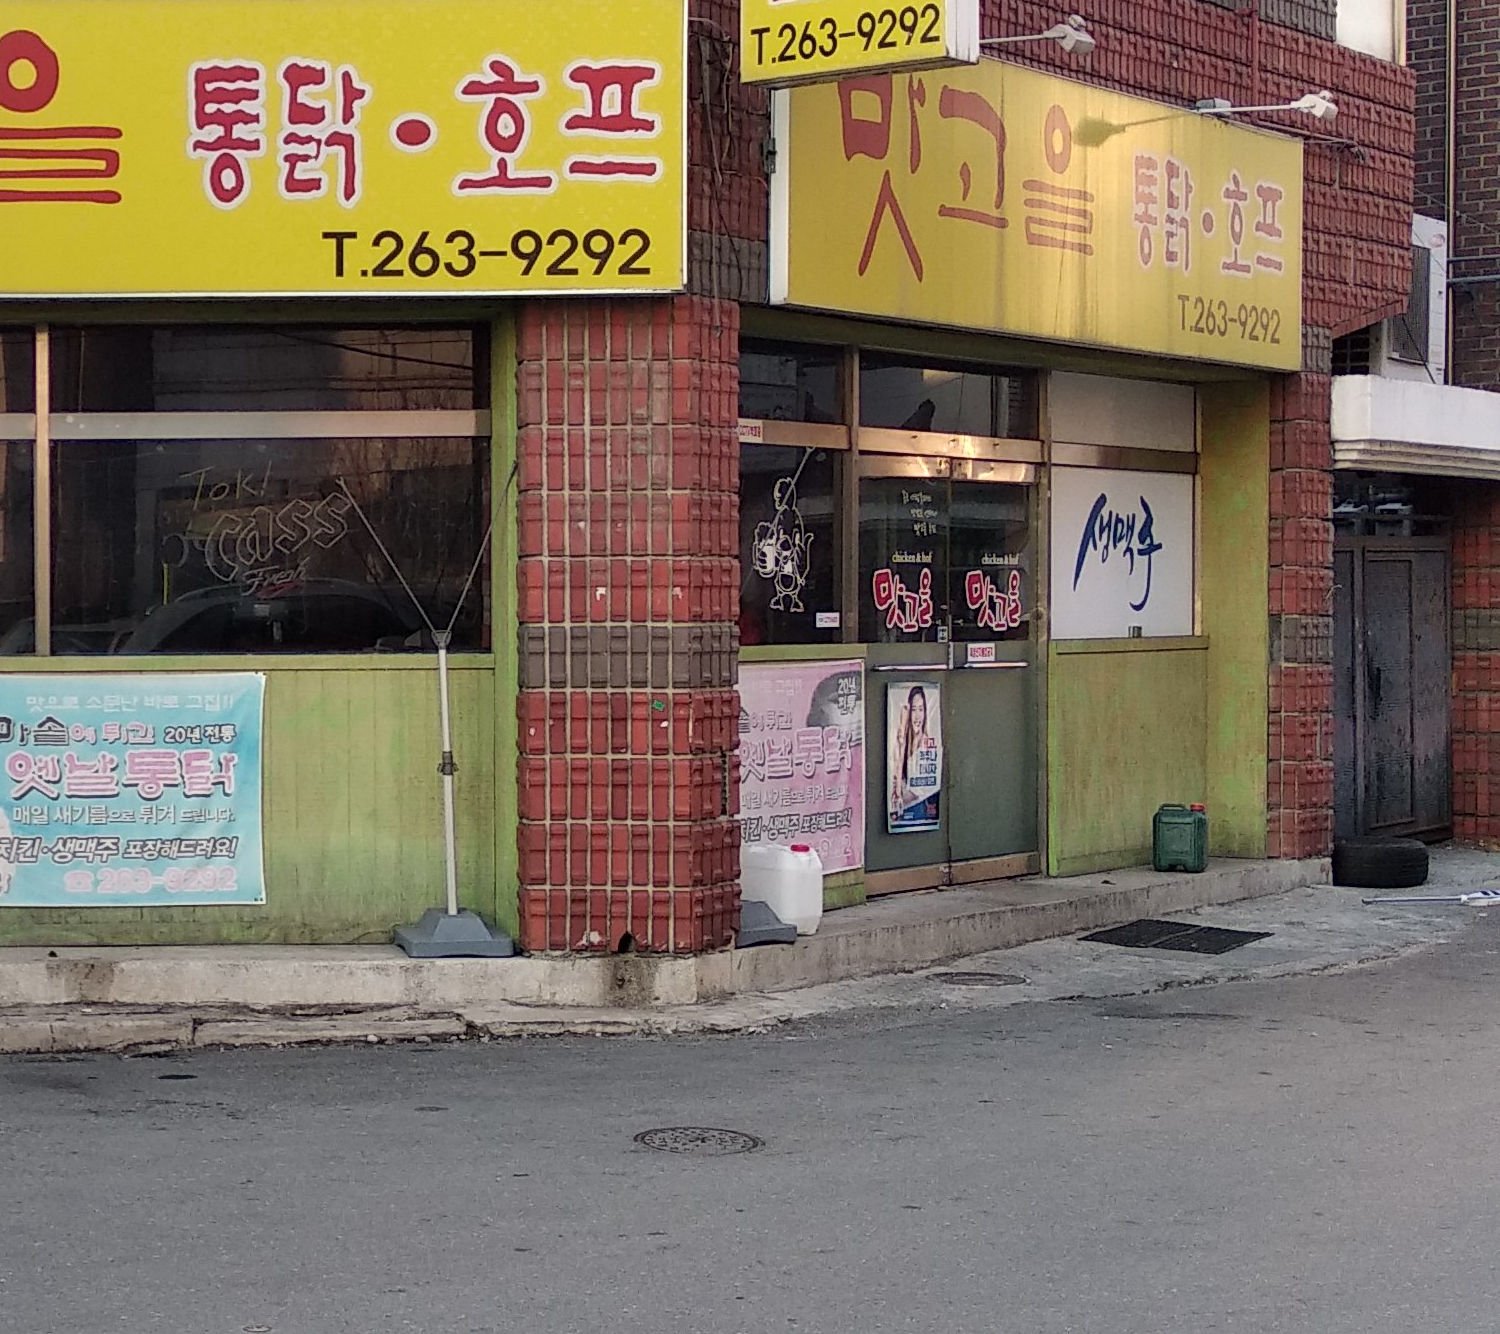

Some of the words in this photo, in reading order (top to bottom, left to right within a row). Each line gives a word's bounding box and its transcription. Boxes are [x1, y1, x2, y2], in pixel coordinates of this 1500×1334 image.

[750, 3, 942, 66] T.263-9292
[837, 75, 1094, 283] 맛고을
[321, 228, 653, 279] T.263-9292
[1177, 293, 1282, 346] T.263-9292
[1073, 493, 1163, 611] 생맥주
[873, 568, 933, 632] 맛고을
[965, 569, 1021, 631] 맛고을
[26, 696, 79, 712] 맛으로
[86, 695, 137, 712] 소문난
[163, 723, 202, 744] 20년
[203, 723, 237, 743] 전통
[12, 805, 50, 825] 매일
[53, 805, 135, 825] 새기름으로
[139, 805, 176, 824] 튀겨
